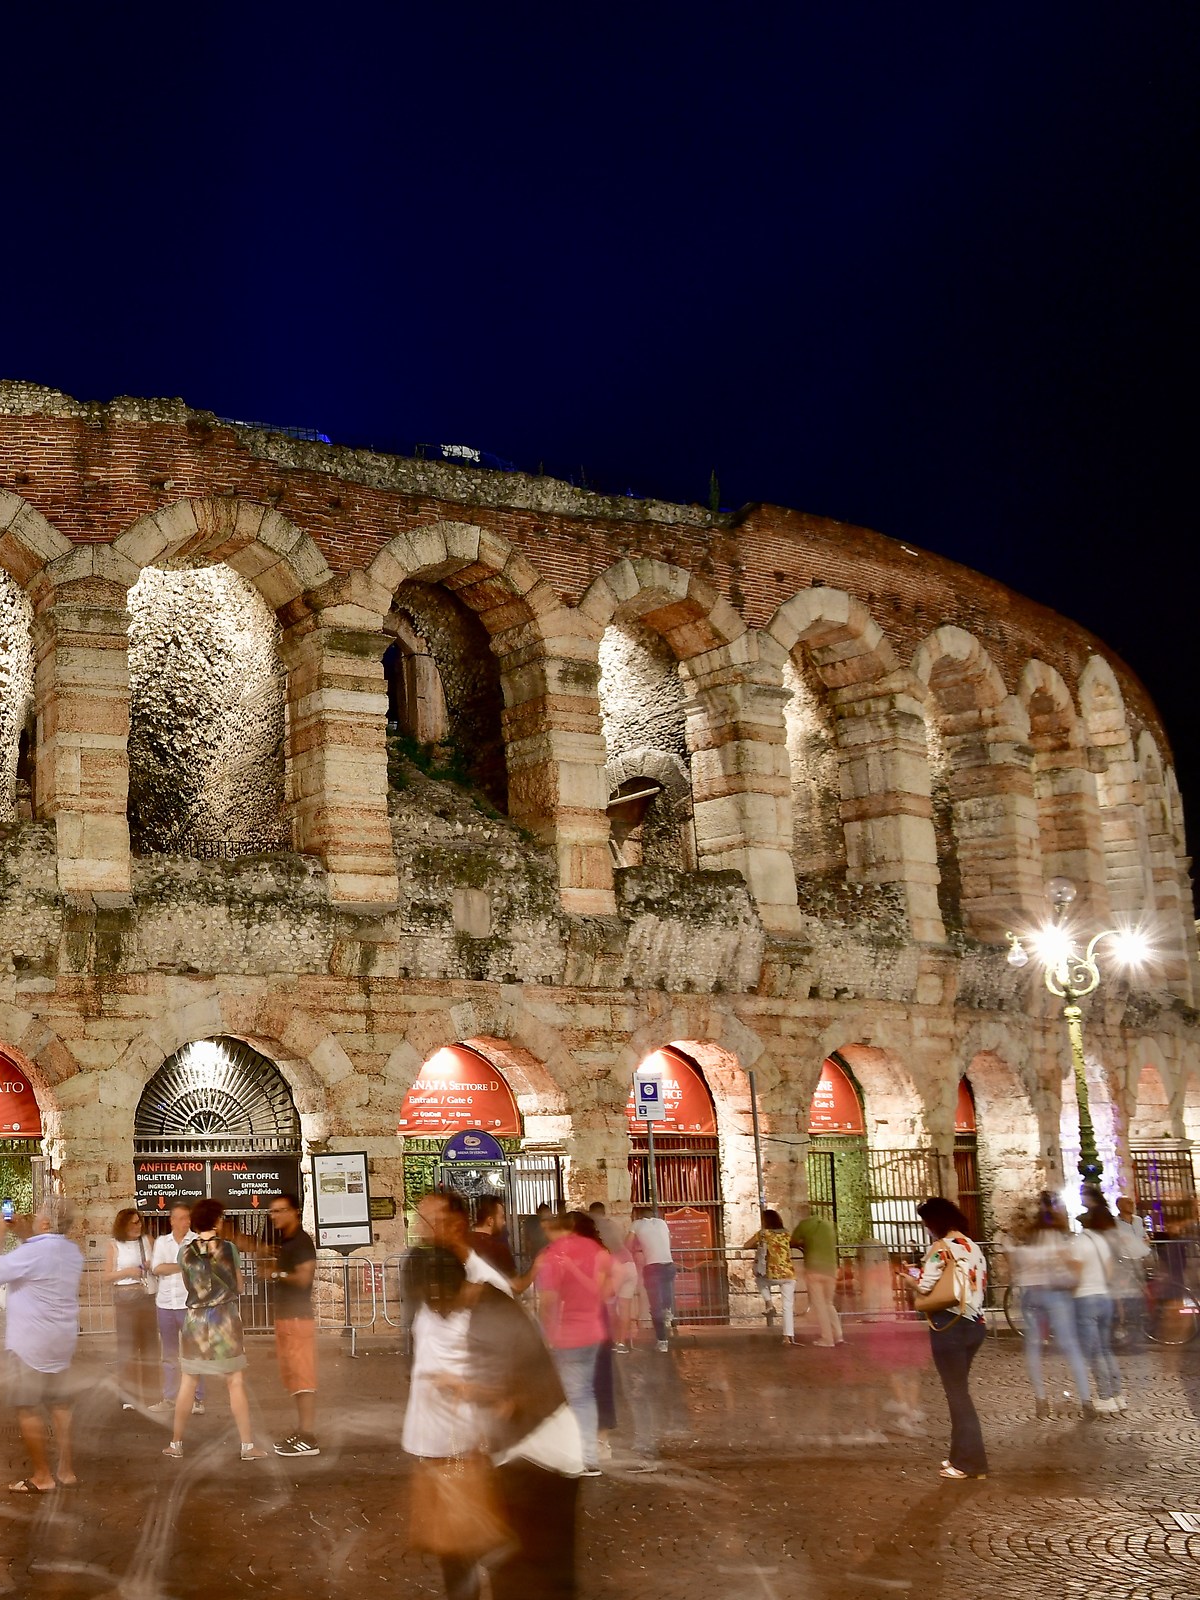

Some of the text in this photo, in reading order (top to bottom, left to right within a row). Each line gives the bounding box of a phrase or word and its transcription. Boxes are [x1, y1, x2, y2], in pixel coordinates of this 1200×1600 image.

[490, 1081, 499, 1091] D
[408, 1096, 473, 1105] Entrata / Gate 6
[674, 1101, 680, 1109] 7
[829, 1100, 835, 1109] 8
[139, 1162, 248, 1172] ANFITEATRO ARENA
[158, 1189, 178, 1197] Gruppi
[181, 1189, 203, 1197] Groups
[228, 1189, 248, 1197] Singoli
